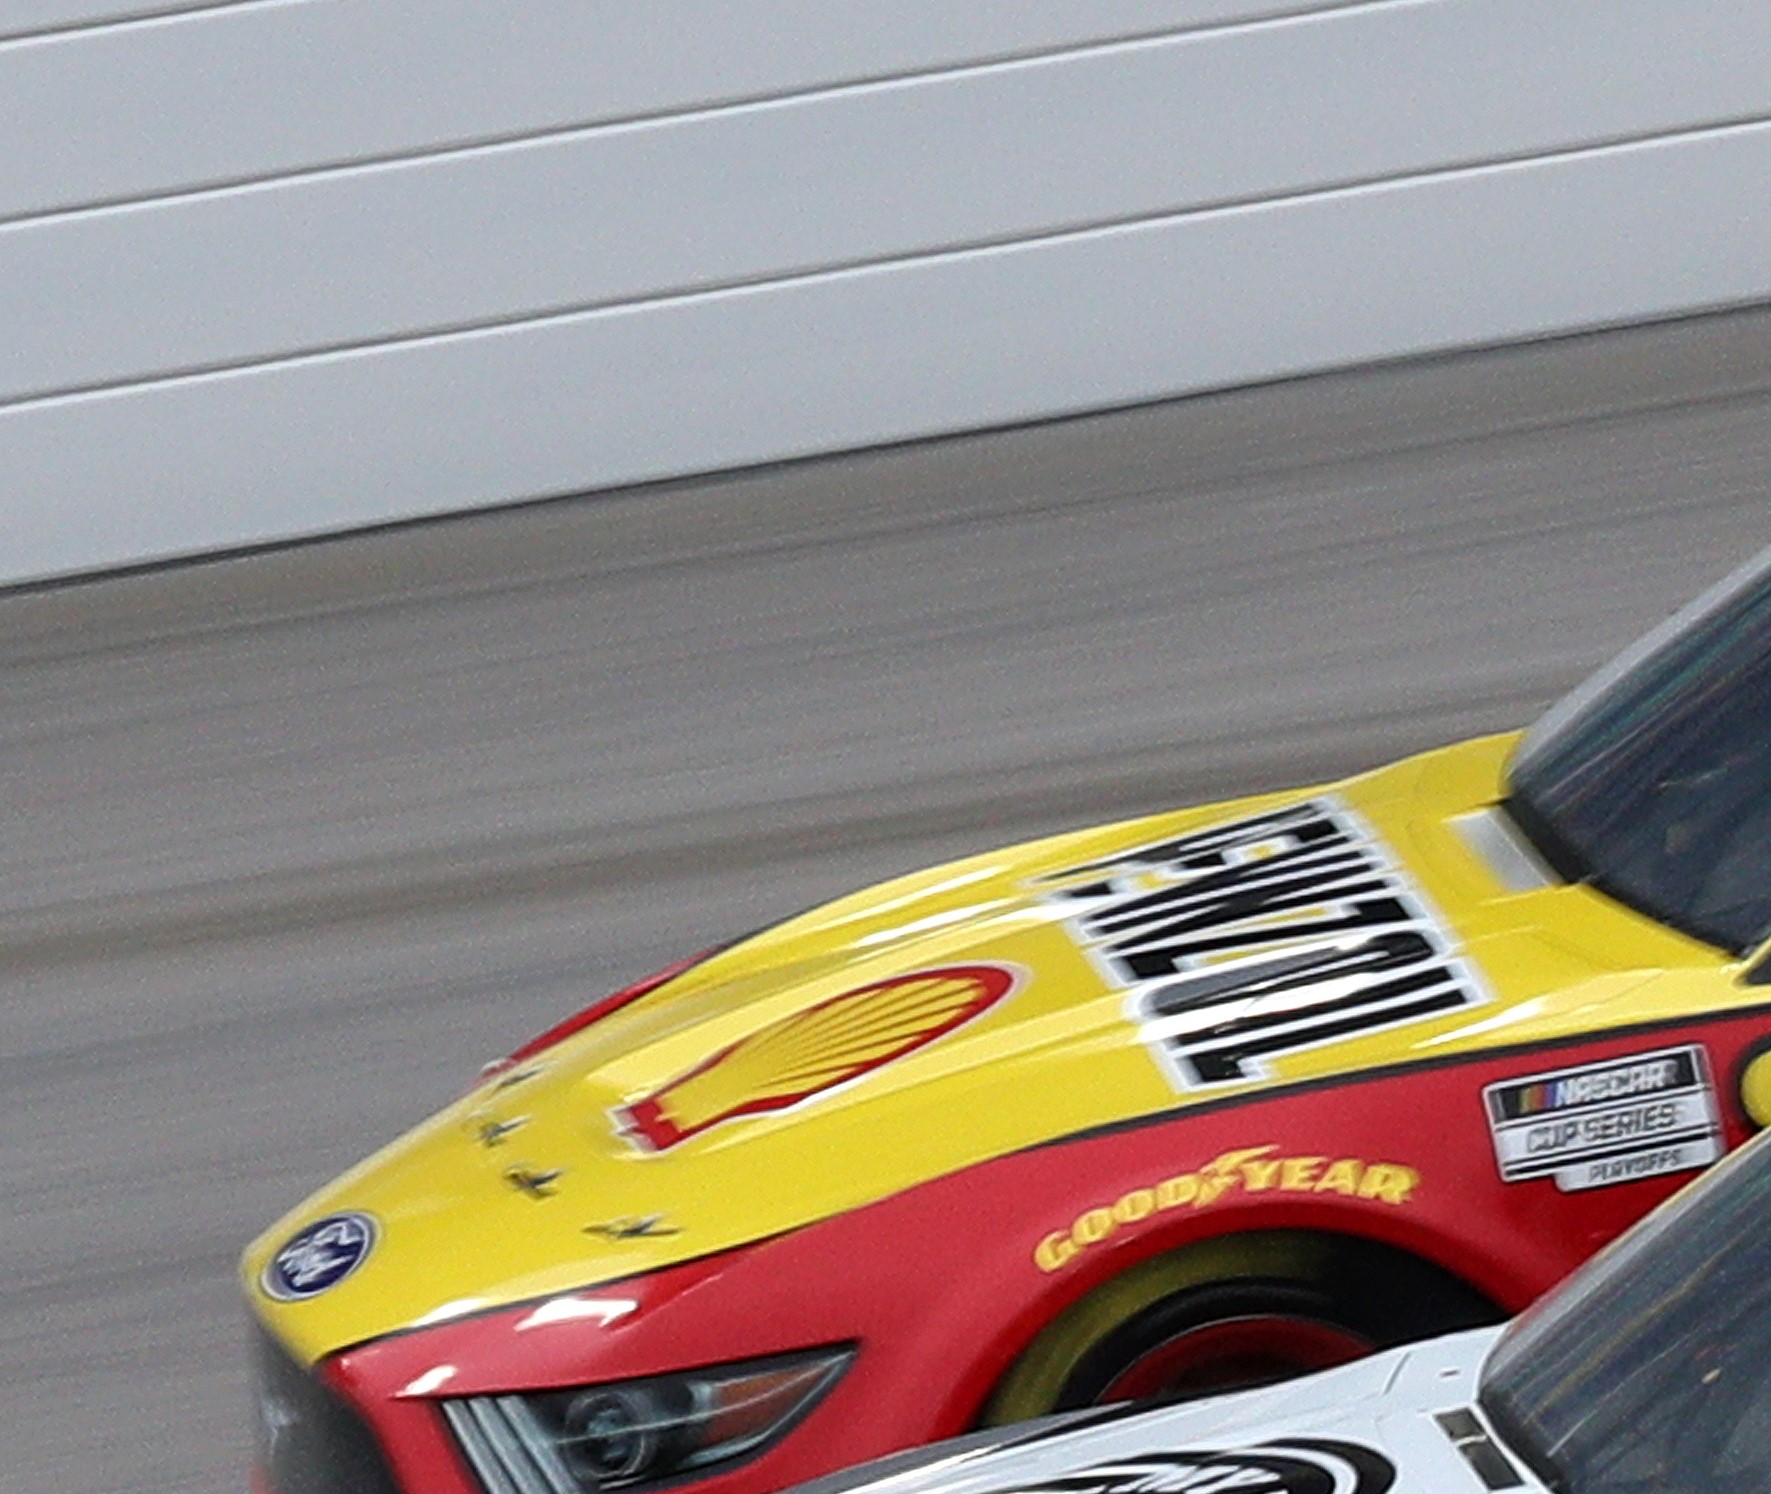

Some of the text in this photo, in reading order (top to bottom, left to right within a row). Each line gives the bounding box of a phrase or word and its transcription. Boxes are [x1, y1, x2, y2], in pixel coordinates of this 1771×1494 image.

[1555, 1059, 1674, 1107] NASCAR
[1527, 1102, 1678, 1152] CUP SERIES
[1033, 1144, 1418, 1274] GOODYEAR
